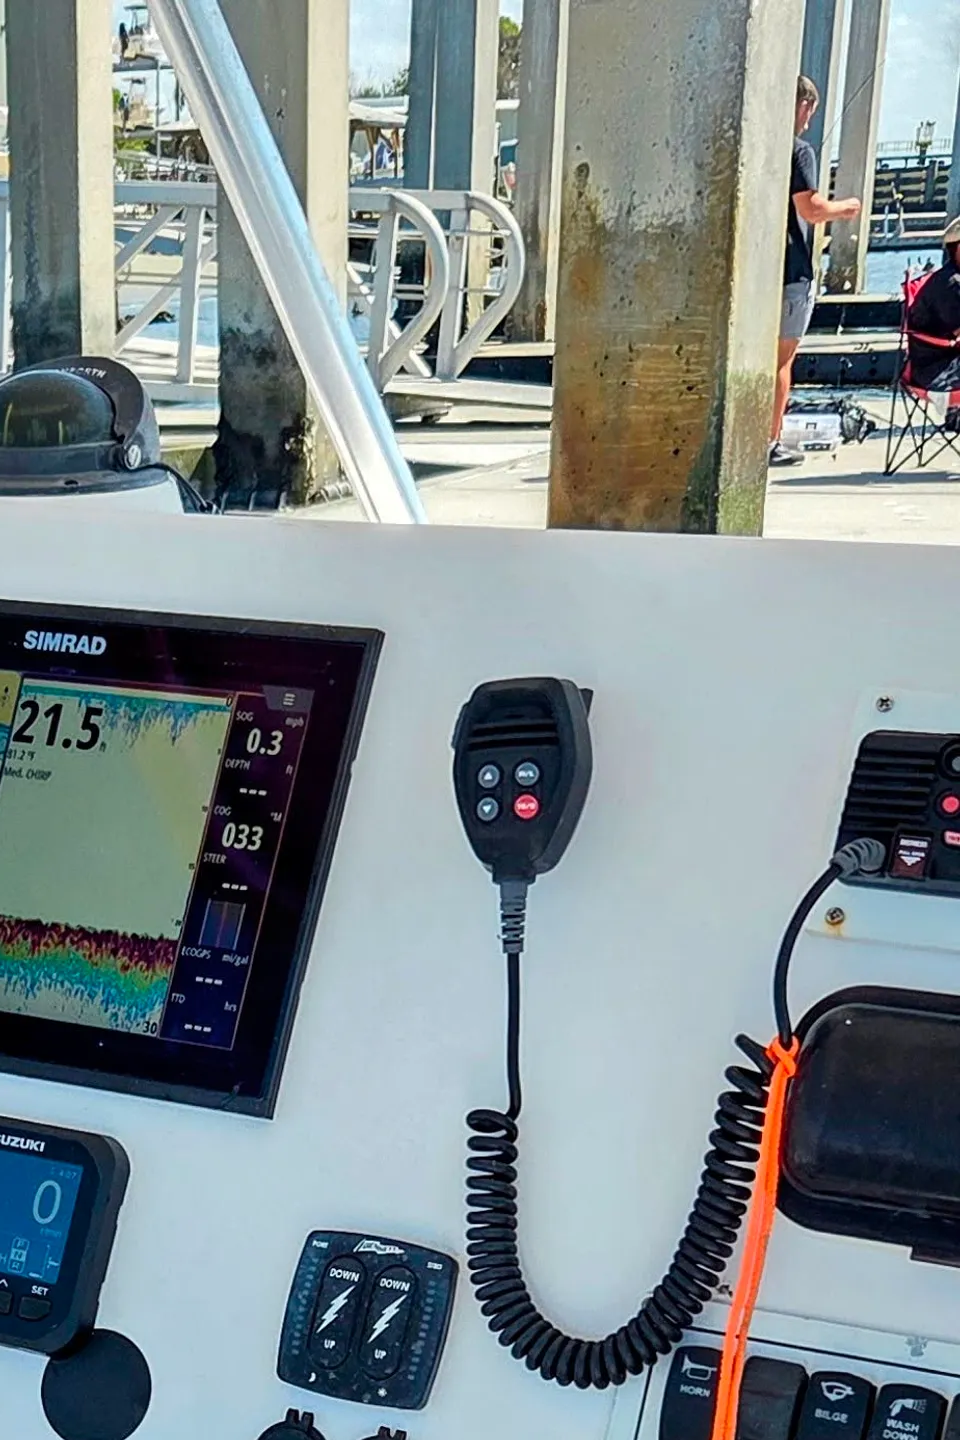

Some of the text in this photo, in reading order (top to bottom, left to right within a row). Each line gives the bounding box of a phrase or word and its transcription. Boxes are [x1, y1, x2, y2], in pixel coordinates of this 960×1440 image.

[23, 630, 107, 655] SIMRAD
[236, 711, 254, 722] SOG
[12, 700, 103, 750] 21.5
[246, 728, 283, 755] 0.3
[225, 758, 250, 770] DEPTH
[214, 805, 232, 816] COG
[221, 822, 264, 850] 033
[203, 852, 228, 864] STEER
[224, 1001, 237, 1012] hrs
[143, 1021, 158, 1034] 30
[32, 1179, 62, 1225] 0
[329, 1268, 360, 1283] DOWN
[31, 1285, 50, 1296] SET
[379, 1278, 410, 1292] DOWN
[324, 1339, 336, 1349] UP
[374, 1349, 386, 1359] UP
[680, 1384, 711, 1398] HORN
[814, 1408, 848, 1424] BILGE
[885, 1418, 920, 1434] WASH
